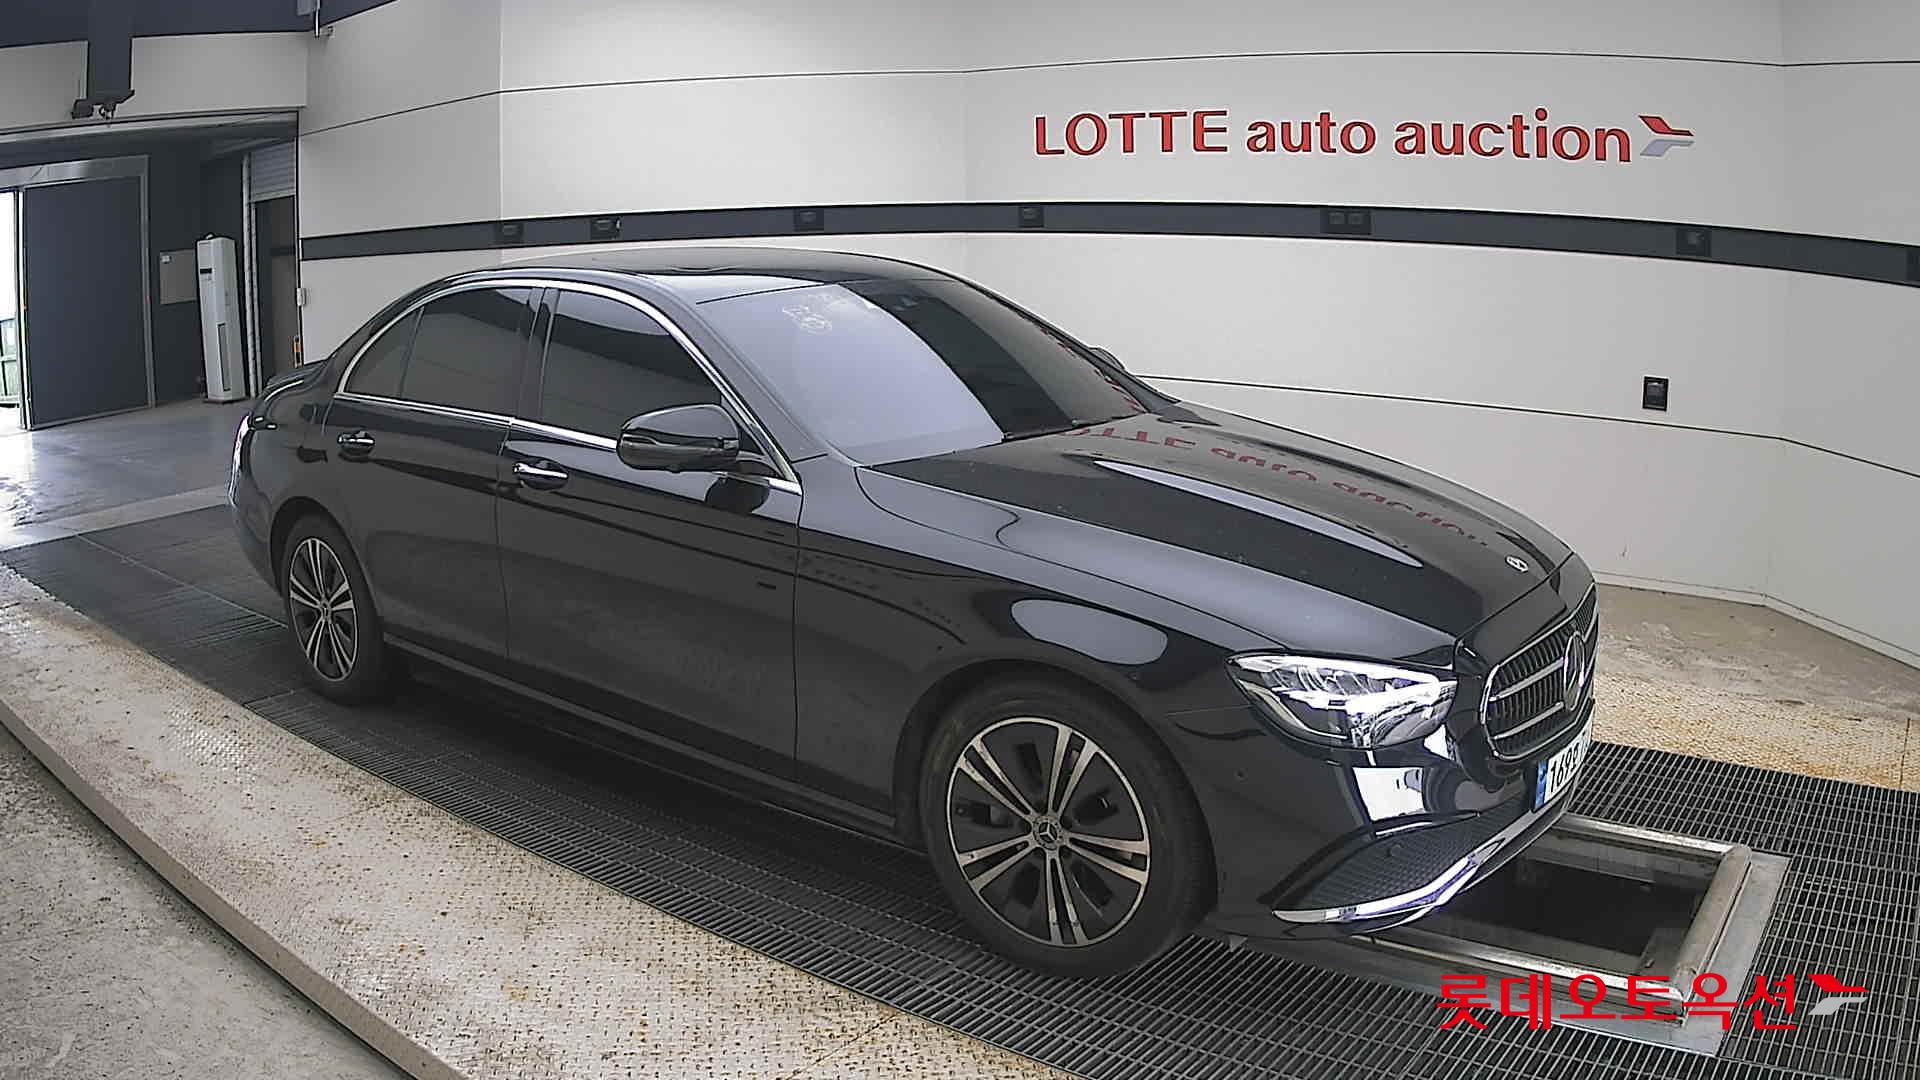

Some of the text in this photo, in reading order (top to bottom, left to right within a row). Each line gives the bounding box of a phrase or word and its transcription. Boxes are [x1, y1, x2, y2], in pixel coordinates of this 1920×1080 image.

[1034, 107, 1632, 163] LOTTE auto auction
